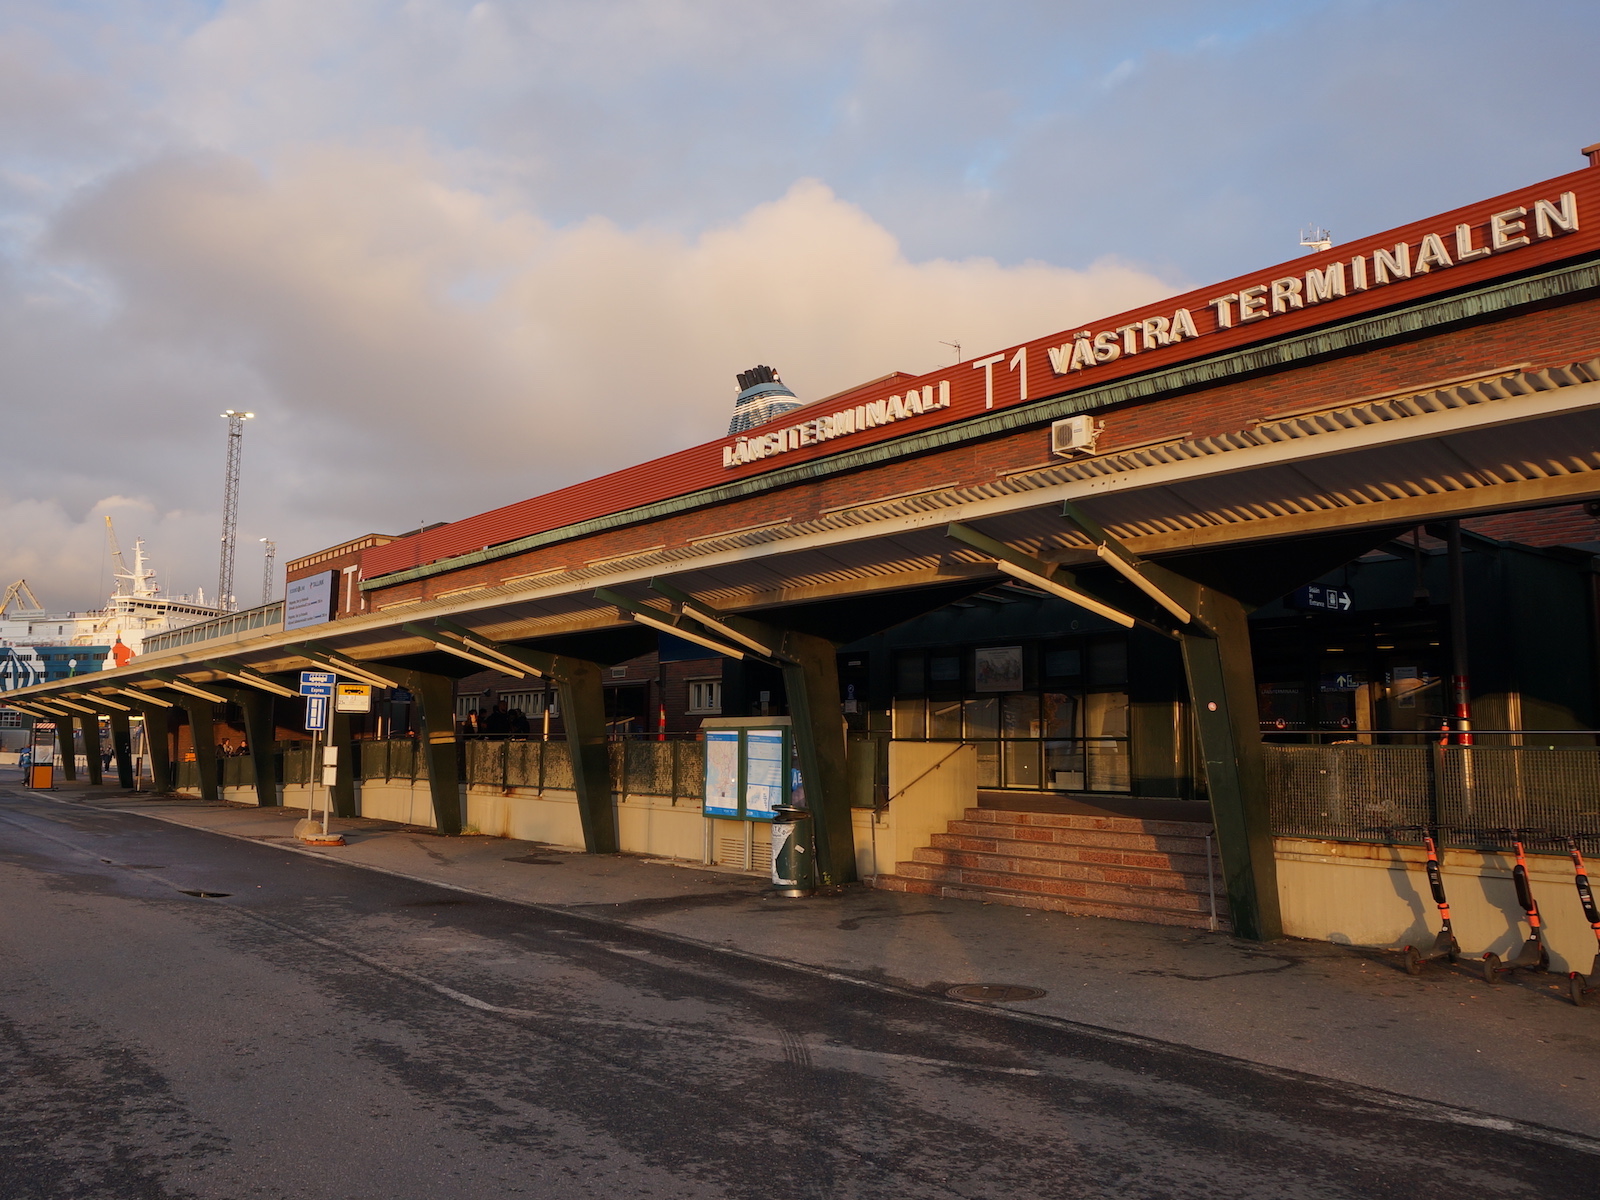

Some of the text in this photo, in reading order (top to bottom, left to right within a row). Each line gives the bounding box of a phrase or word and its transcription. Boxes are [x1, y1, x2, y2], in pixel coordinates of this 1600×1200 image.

[722, 190, 1581, 469] LÄNSITERMINAALI T1 VÄSTRA TERMINALEN
